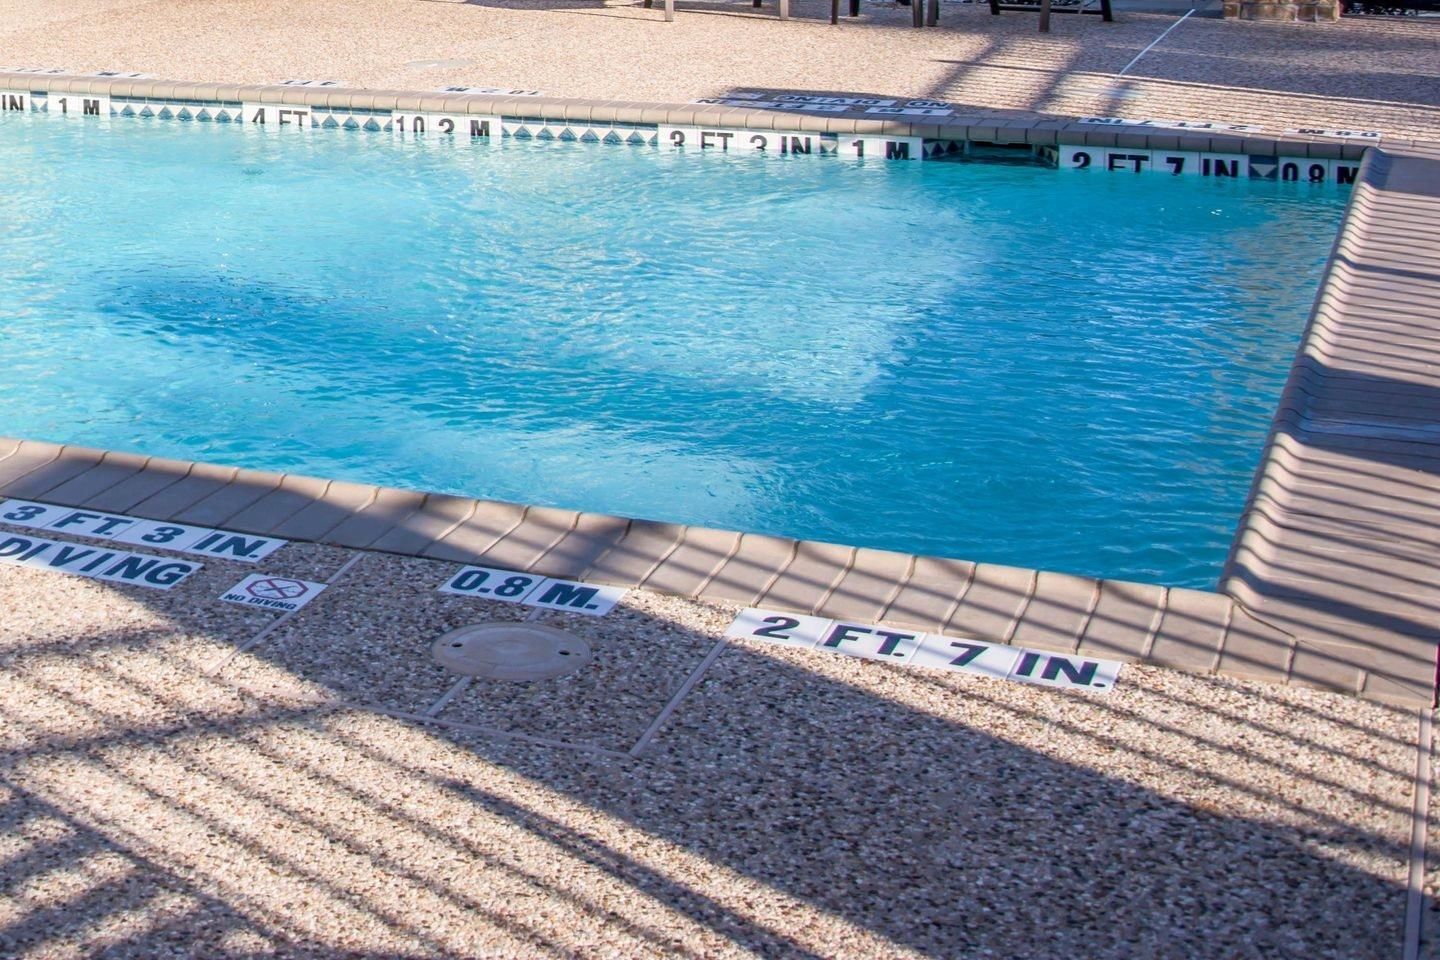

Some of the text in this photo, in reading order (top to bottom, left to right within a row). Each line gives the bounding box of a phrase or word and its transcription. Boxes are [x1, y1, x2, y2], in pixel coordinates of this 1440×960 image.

[2, 94, 24, 111] IN
[781, 135, 811, 154] IN
[1165, 157, 1186, 175] 7
[1203, 158, 1239, 177] IN
[4, 505, 46, 522] 3
[142, 526, 186, 544] 3
[450, 568, 533, 599] 0.8
[224, 593, 297, 610] NO DIVING
[755, 616, 800, 640] 2
[949, 642, 992, 667] 7
